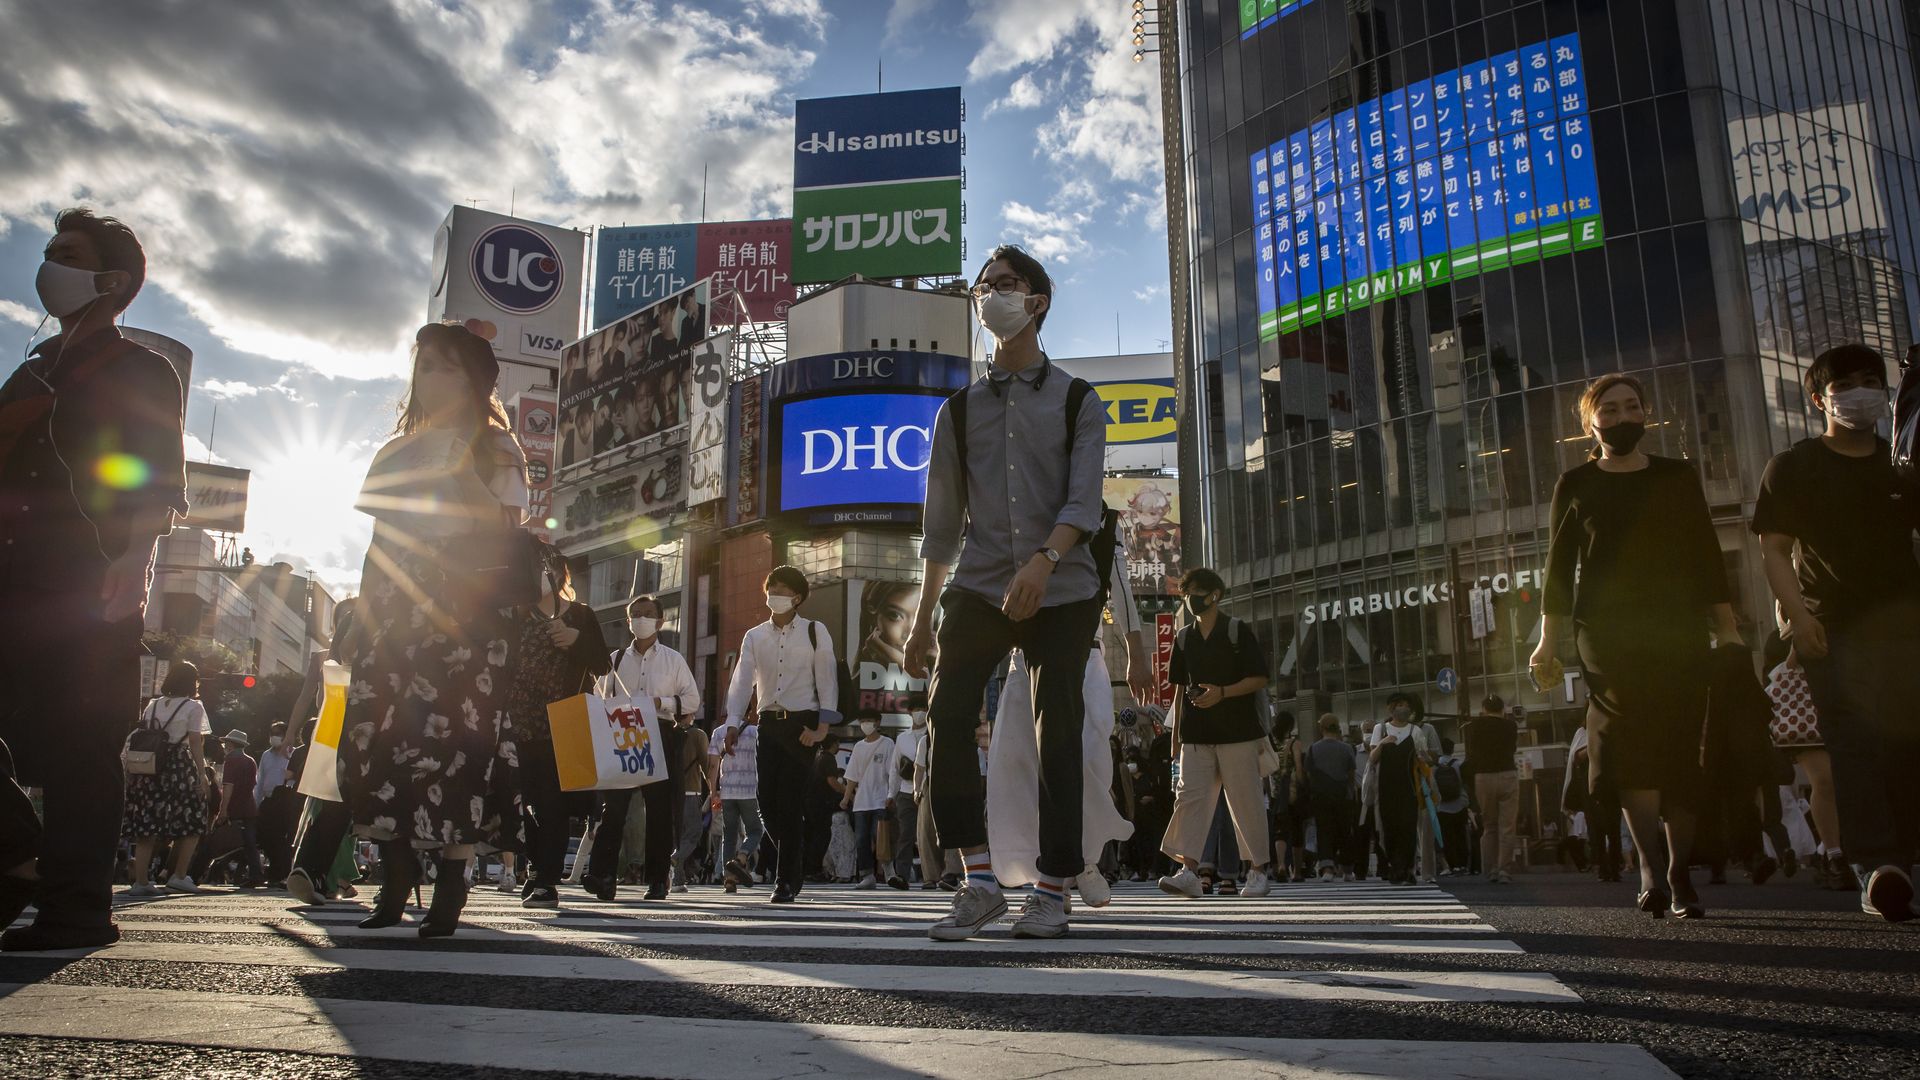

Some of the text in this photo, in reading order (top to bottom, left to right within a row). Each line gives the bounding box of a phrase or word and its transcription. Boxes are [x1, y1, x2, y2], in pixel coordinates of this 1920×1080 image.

[797, 128, 959, 154] Hisamitsu
[803, 207, 951, 254] サロンパス
[617, 245, 677, 273] 龍角散
[718, 241, 779, 268] 龍角散
[607, 272, 686, 300] ダイレクト
[711, 268, 789, 294] ダイレクト
[1326, 259, 1443, 311] ECONOMY
[524, 333, 564, 351] VISA
[832, 356, 894, 380] DHC
[801, 425, 930, 475] DHC
[834, 512, 892, 521] DHC Channel
[1304, 581, 1455, 625] STARBUCKS
